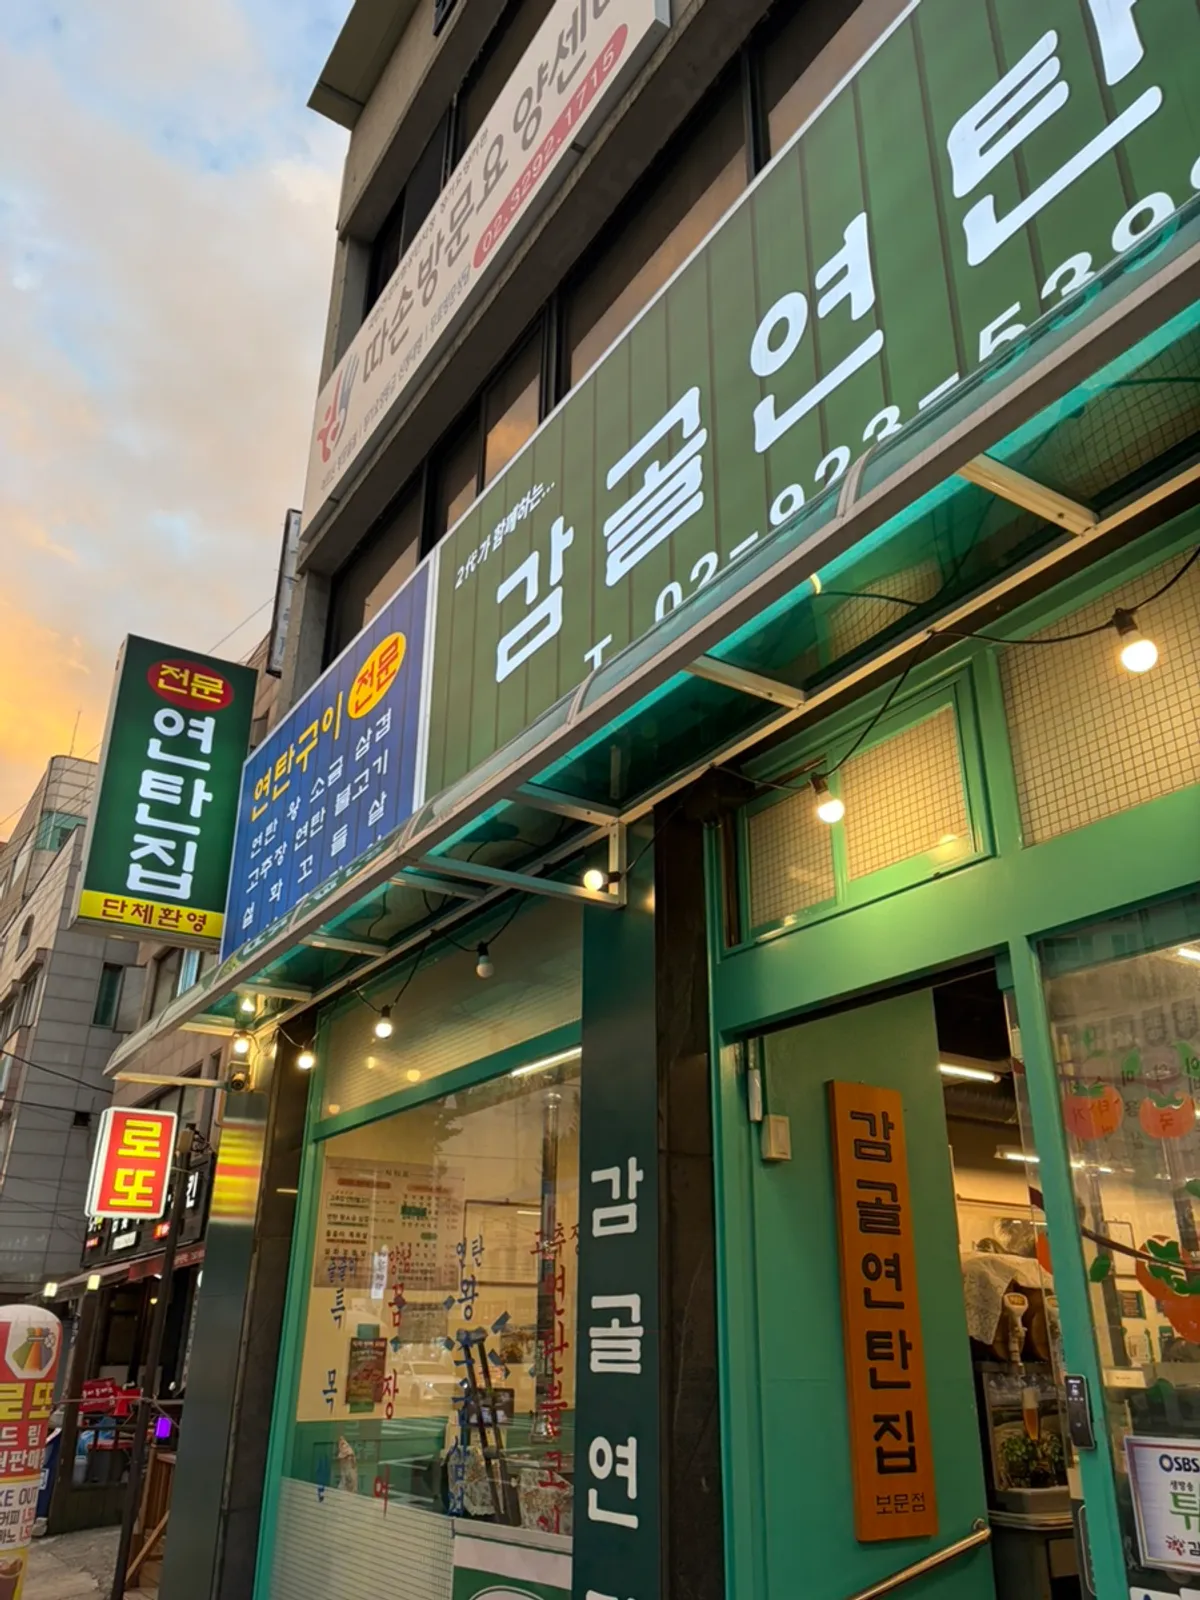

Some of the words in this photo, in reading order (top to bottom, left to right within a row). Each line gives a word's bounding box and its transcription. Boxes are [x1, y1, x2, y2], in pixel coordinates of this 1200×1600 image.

[363, 0, 610, 383] 따손방문요양센
[482, 43, 615, 253] 02.3292.1715
[158, 663, 225, 705] 전문
[252, 691, 343, 822] 연탄구이
[354, 636, 399, 713] 전문
[126, 708, 215, 900] 연탄집
[246, 841, 288, 893] 고추장
[294, 806, 326, 851] 연탄
[334, 748, 389, 817] 불고기
[251, 818, 278, 858] 연탄
[101, 899, 208, 933] 단체환영
[109, 1118, 162, 1208] 로또
[850, 1110, 918, 1476] 감골연탄집
[875, 1492, 926, 1515] 보문점
[1169, 1491, 1200, 1532] 투
